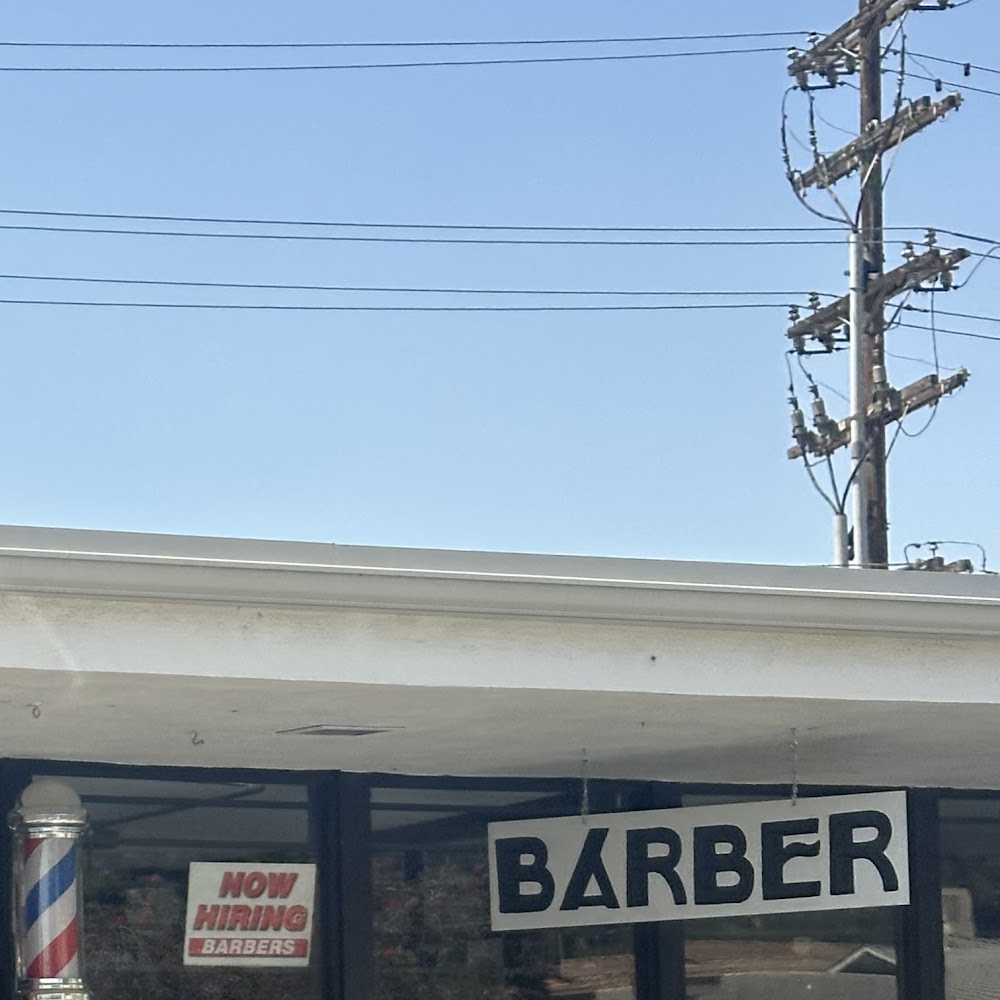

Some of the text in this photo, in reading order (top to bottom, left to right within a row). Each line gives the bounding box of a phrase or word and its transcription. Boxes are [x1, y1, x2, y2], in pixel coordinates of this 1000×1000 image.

[495, 810, 899, 914] BARBER
[218, 871, 299, 899] NOW
[193, 904, 308, 932] HIRING
[201, 939, 296, 955] BARBERS
